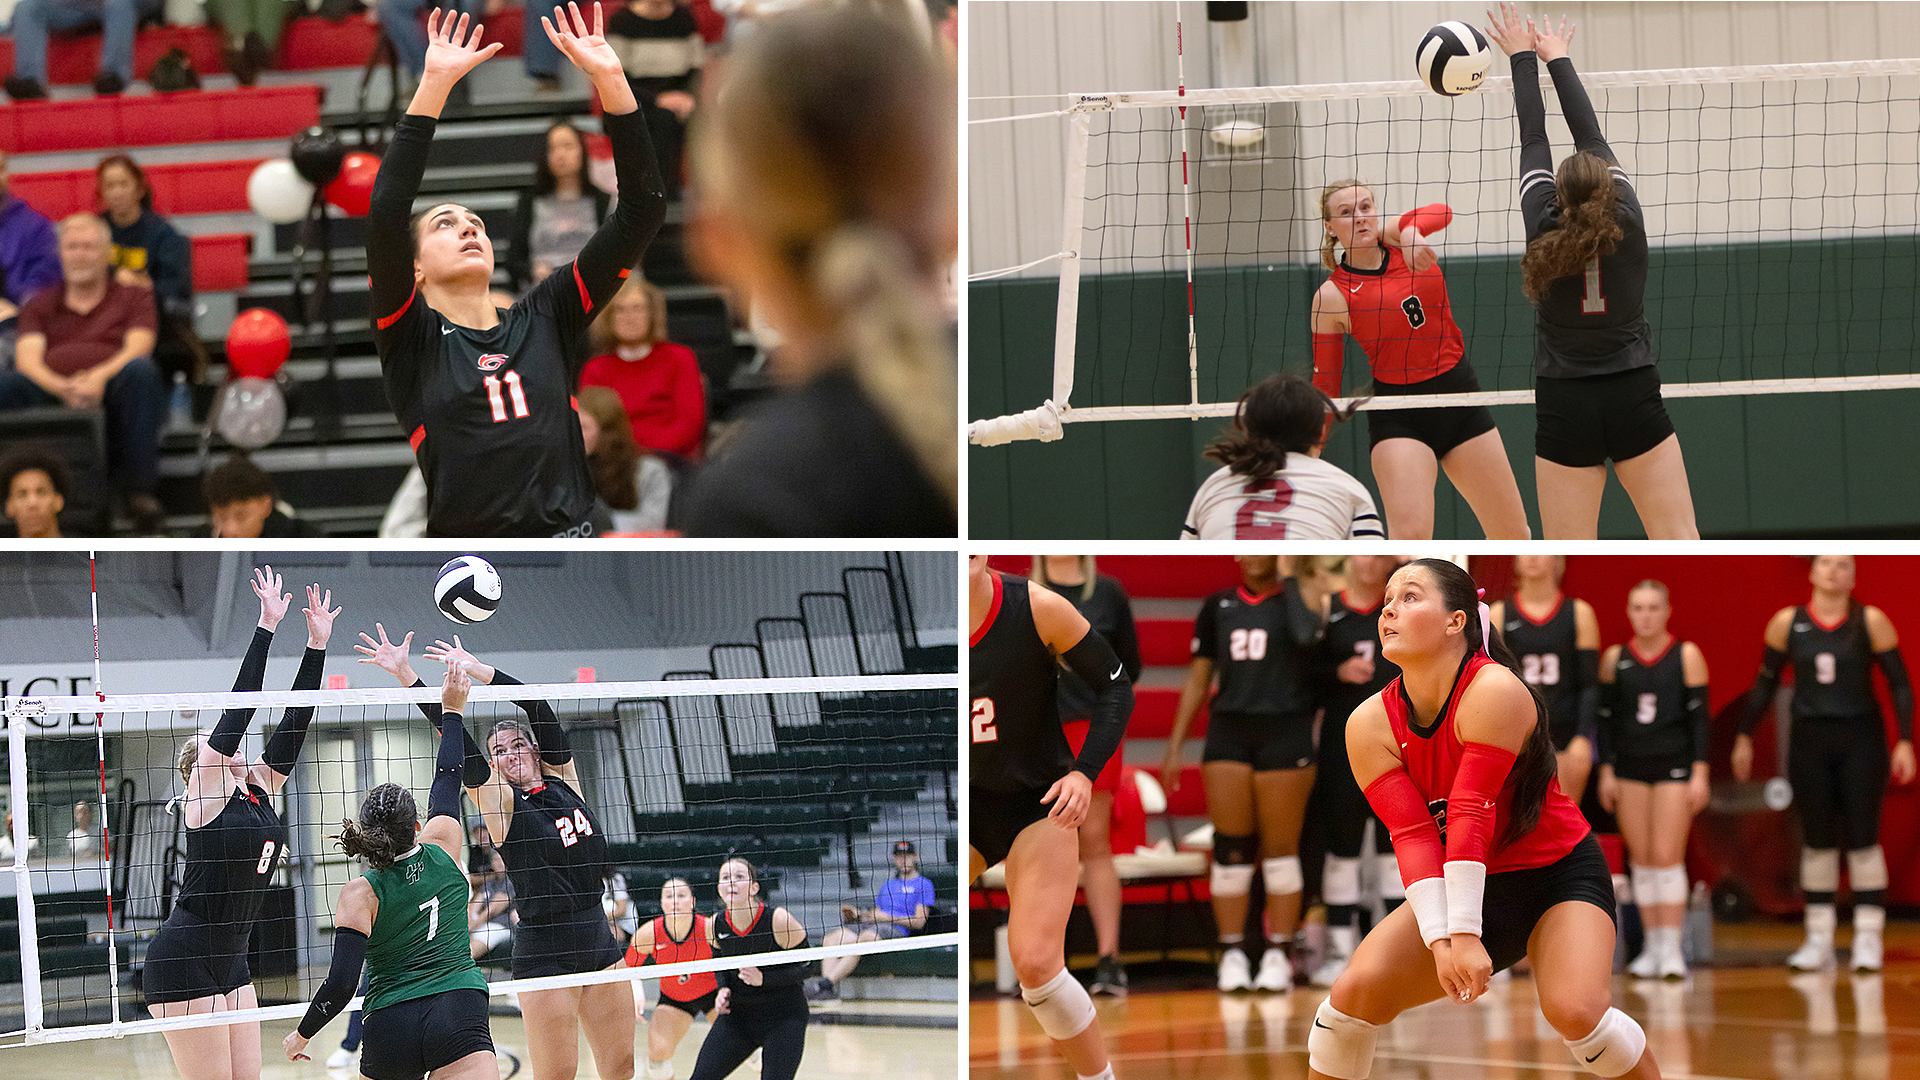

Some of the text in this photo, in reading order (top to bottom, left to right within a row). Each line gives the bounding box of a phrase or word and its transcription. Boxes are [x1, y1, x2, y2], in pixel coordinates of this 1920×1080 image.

[1581, 251, 1608, 315] 1
[1401, 295, 1426, 330] 8
[483, 369, 531, 423] 11
[1232, 476, 1297, 540] 2
[1230, 628, 1268, 661] 20
[1521, 653, 1560, 685] 23
[971, 697, 999, 744] 2
[555, 808, 594, 848] 24
[257, 840, 276, 874] 8
[419, 895, 440, 941] 7
